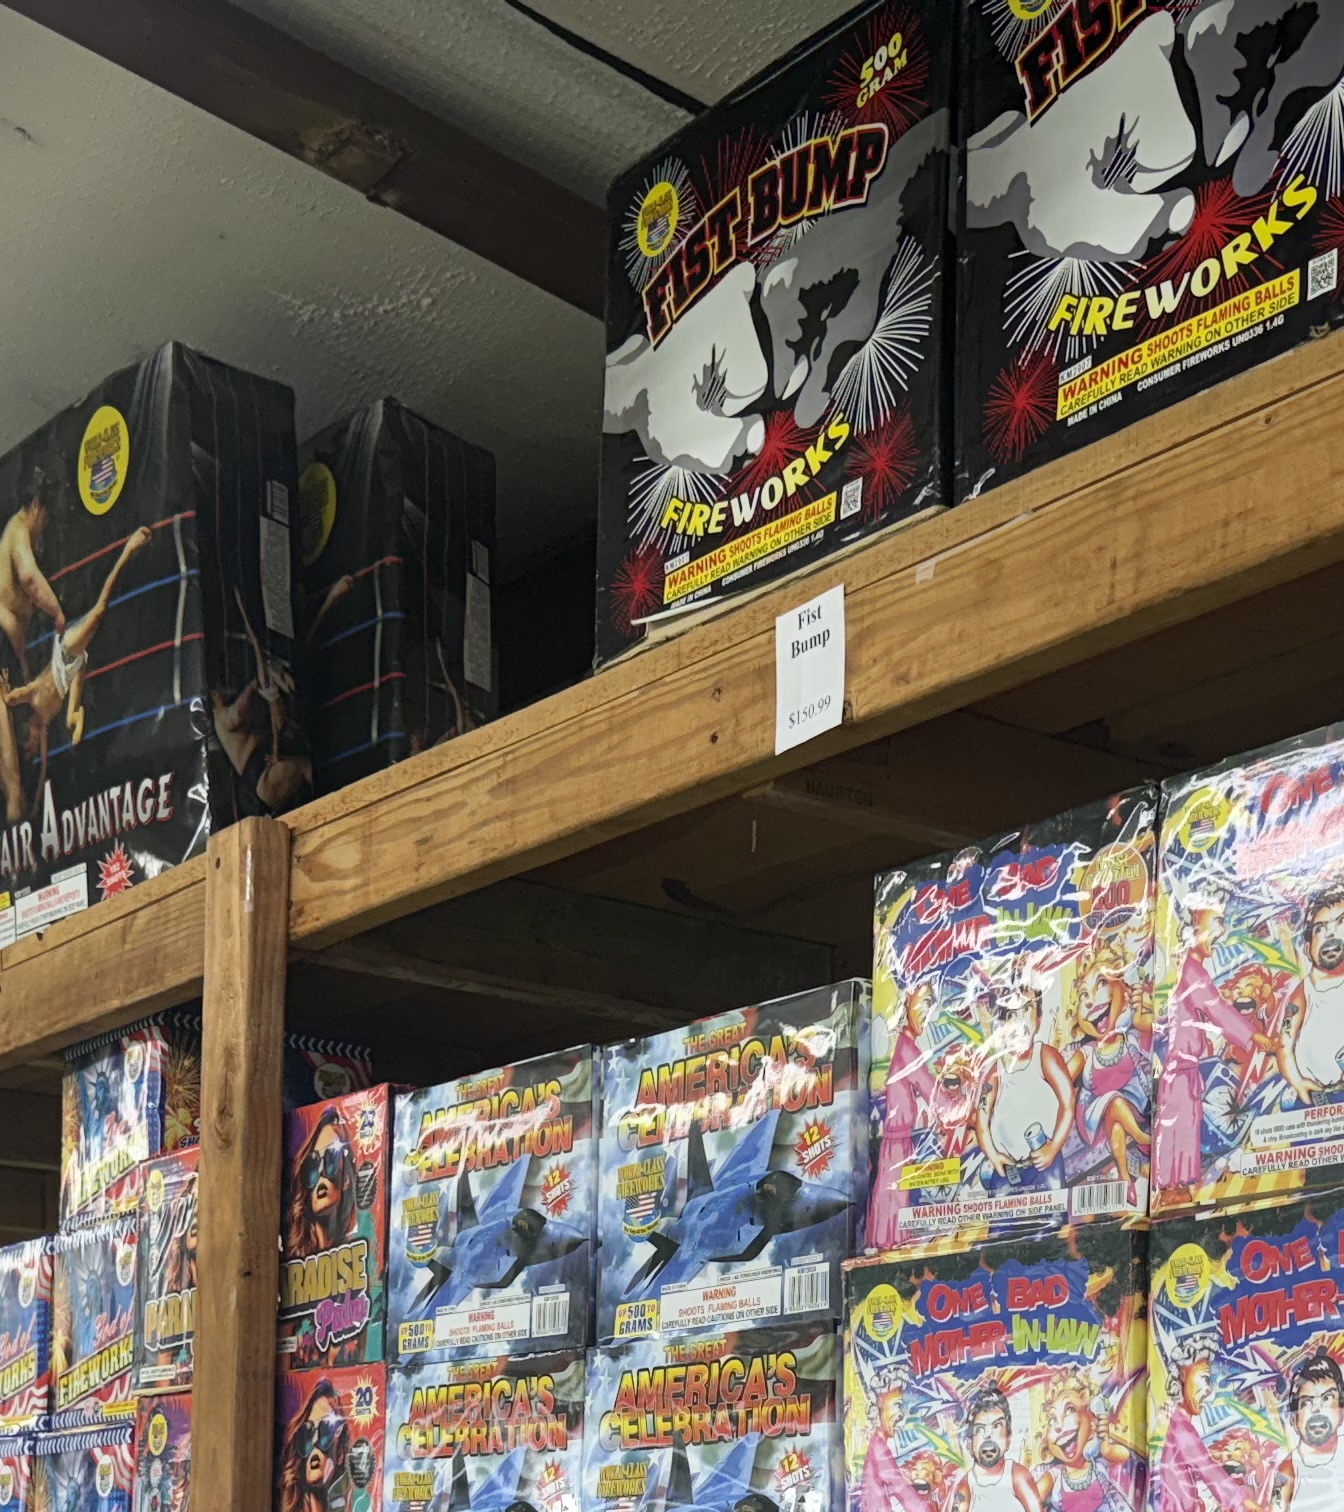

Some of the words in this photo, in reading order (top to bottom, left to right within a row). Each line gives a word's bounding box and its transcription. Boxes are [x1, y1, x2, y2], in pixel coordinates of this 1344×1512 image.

[856, 48, 908, 109] GRAM
[859, 32, 903, 89] 500
[642, 186, 742, 342] FIST
[747, 122, 890, 246] BUMP
[1046, 173, 1318, 336] FIREWORKS
[1062, 346, 1144, 403] WARNING
[1145, 326, 1194, 359] SHOOTS
[1196, 298, 1251, 335] FLAMING
[1254, 274, 1296, 306] BALLS
[660, 411, 851, 537] FIREWORKS
[797, 603, 823, 631] Fist
[790, 628, 831, 660] Bump
[788, 694, 832, 729] $150.99
[41, 770, 175, 864] ADVANTAGE
[683, 1033, 708, 1055] THE
[709, 1021, 748, 1049] GREAT
[801, 1135, 833, 1163] SHOTS
[802, 1126, 821, 1145] 12
[279, 1245, 367, 1307] RADISE
[1240, 1238, 1315, 1283] ONE
[926, 1279, 989, 1322] ONE
[1006, 1274, 1070, 1313] BAD
[619, 1316, 654, 1336] GRAMS
[354, 1385, 372, 1407] 20
[408, 1374, 557, 1426] AMERICA'S
[612, 1351, 798, 1415] AMERICA'S
[396, 1412, 569, 1460] CELEBRATION
[599, 1392, 813, 1451] CELEBRATION
